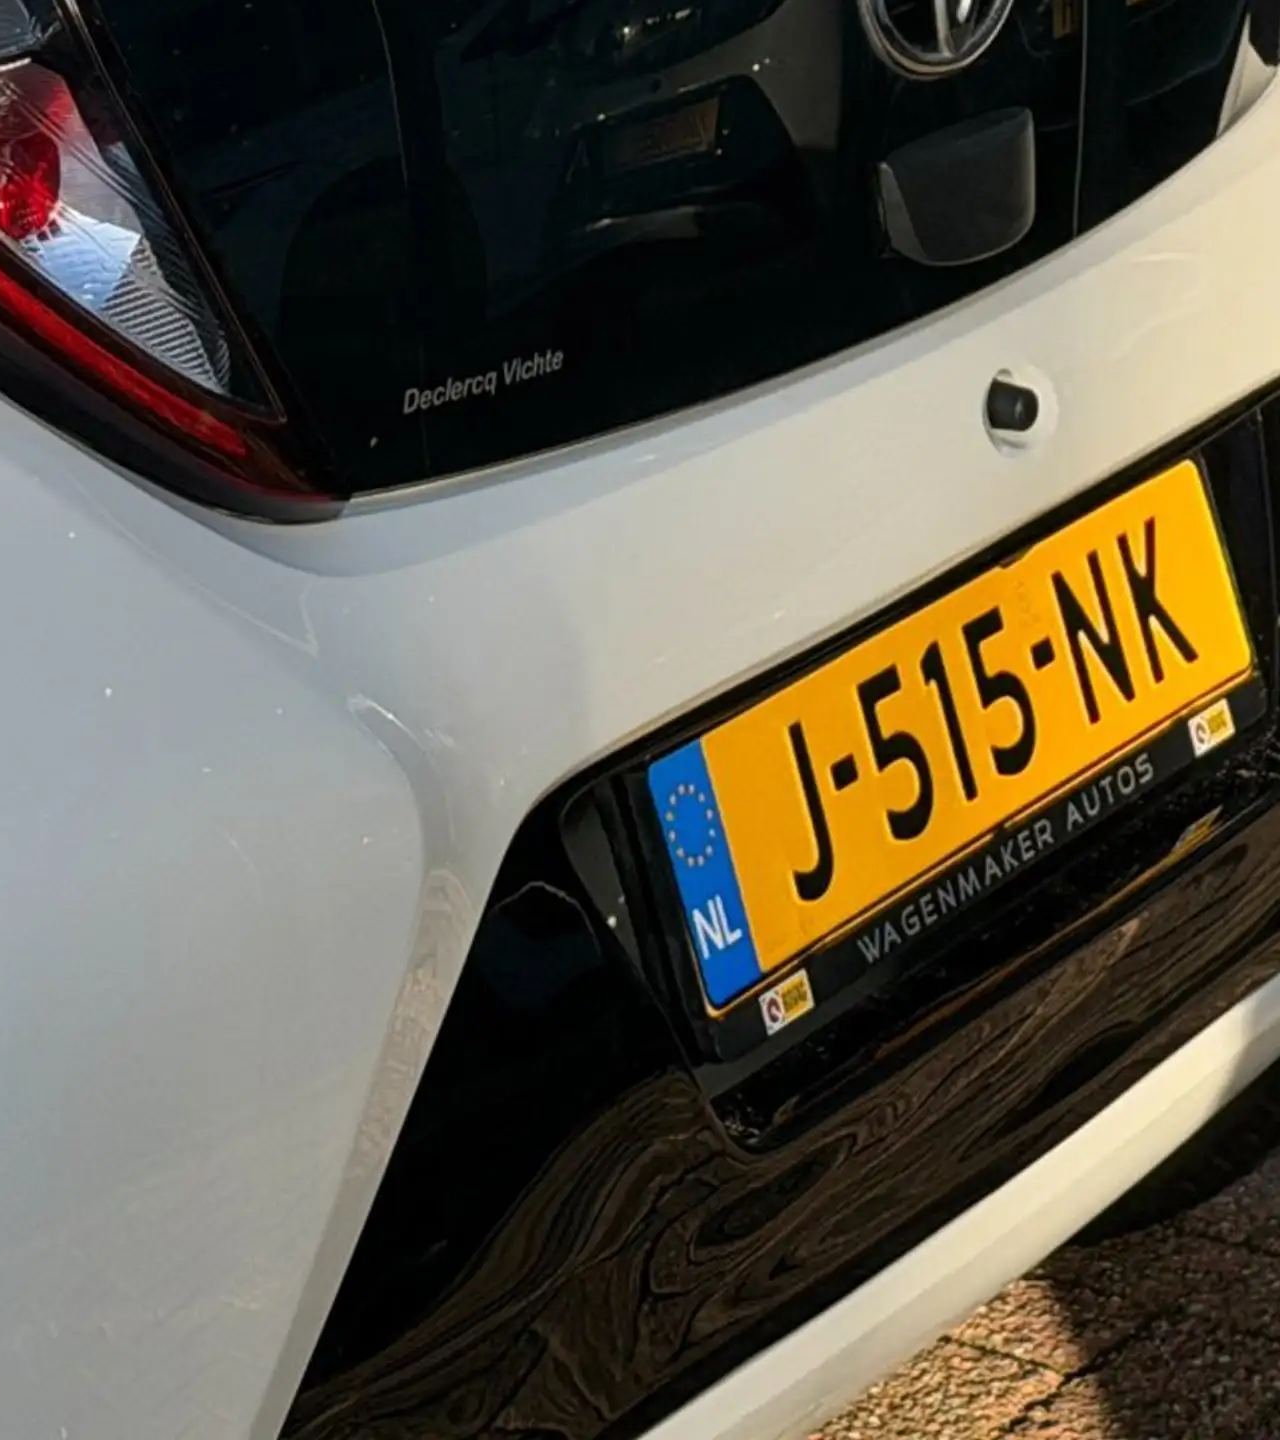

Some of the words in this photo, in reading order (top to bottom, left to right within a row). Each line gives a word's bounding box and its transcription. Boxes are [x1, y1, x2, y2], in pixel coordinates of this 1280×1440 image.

[403, 371, 498, 415] Declercq
[502, 349, 564, 386] Vichte
[786, 516, 1200, 903] J-515-NK
[691, 895, 743, 961] NL
[856, 818, 1055, 965] WAGENMAKER
[1065, 751, 1155, 832] AUTOS
